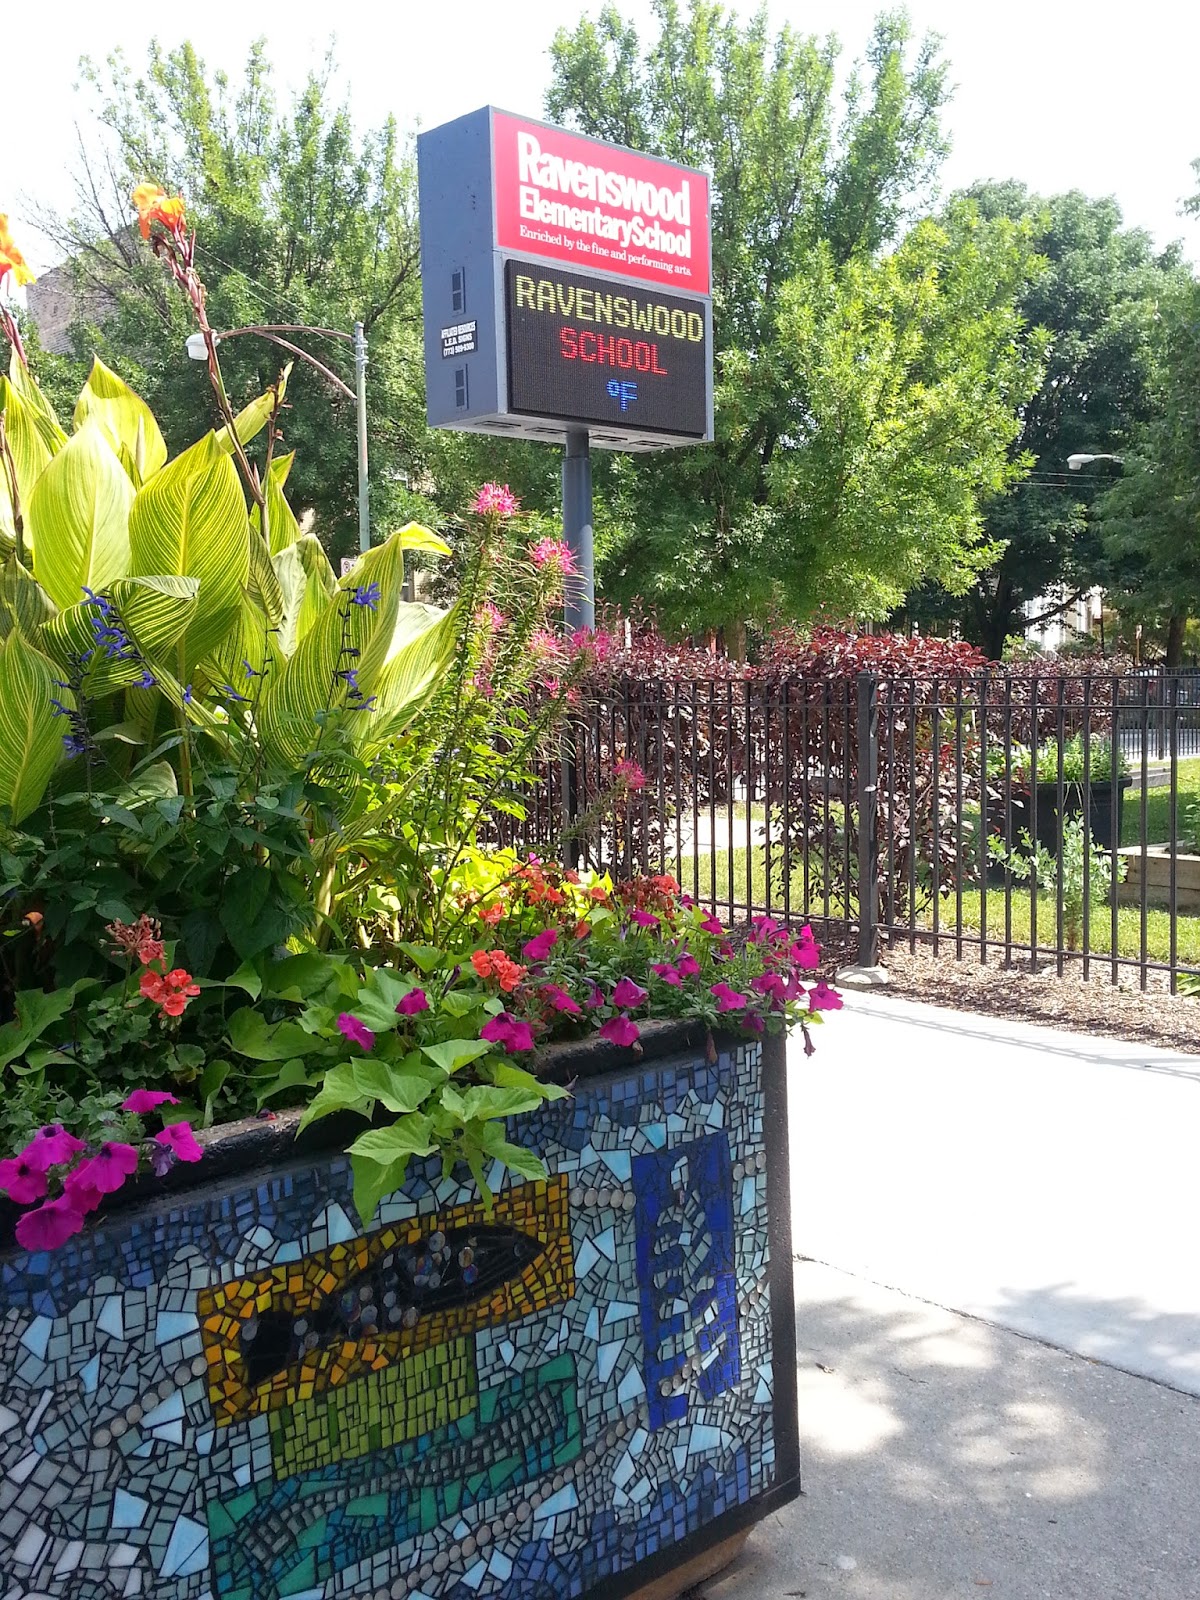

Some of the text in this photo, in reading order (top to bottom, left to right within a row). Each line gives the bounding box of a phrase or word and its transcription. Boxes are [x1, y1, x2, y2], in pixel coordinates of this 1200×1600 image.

[517, 131, 691, 226] Ravenswood
[520, 225, 562, 246] Enriched
[563, 235, 575, 250] by
[576, 240, 590, 253] the
[591, 243, 610, 257] fine
[610, 248, 627, 261] and
[628, 254, 674, 274] performing
[516, 275, 704, 342] RAVENSWOOD
[559, 327, 668, 375] SCHOOL
